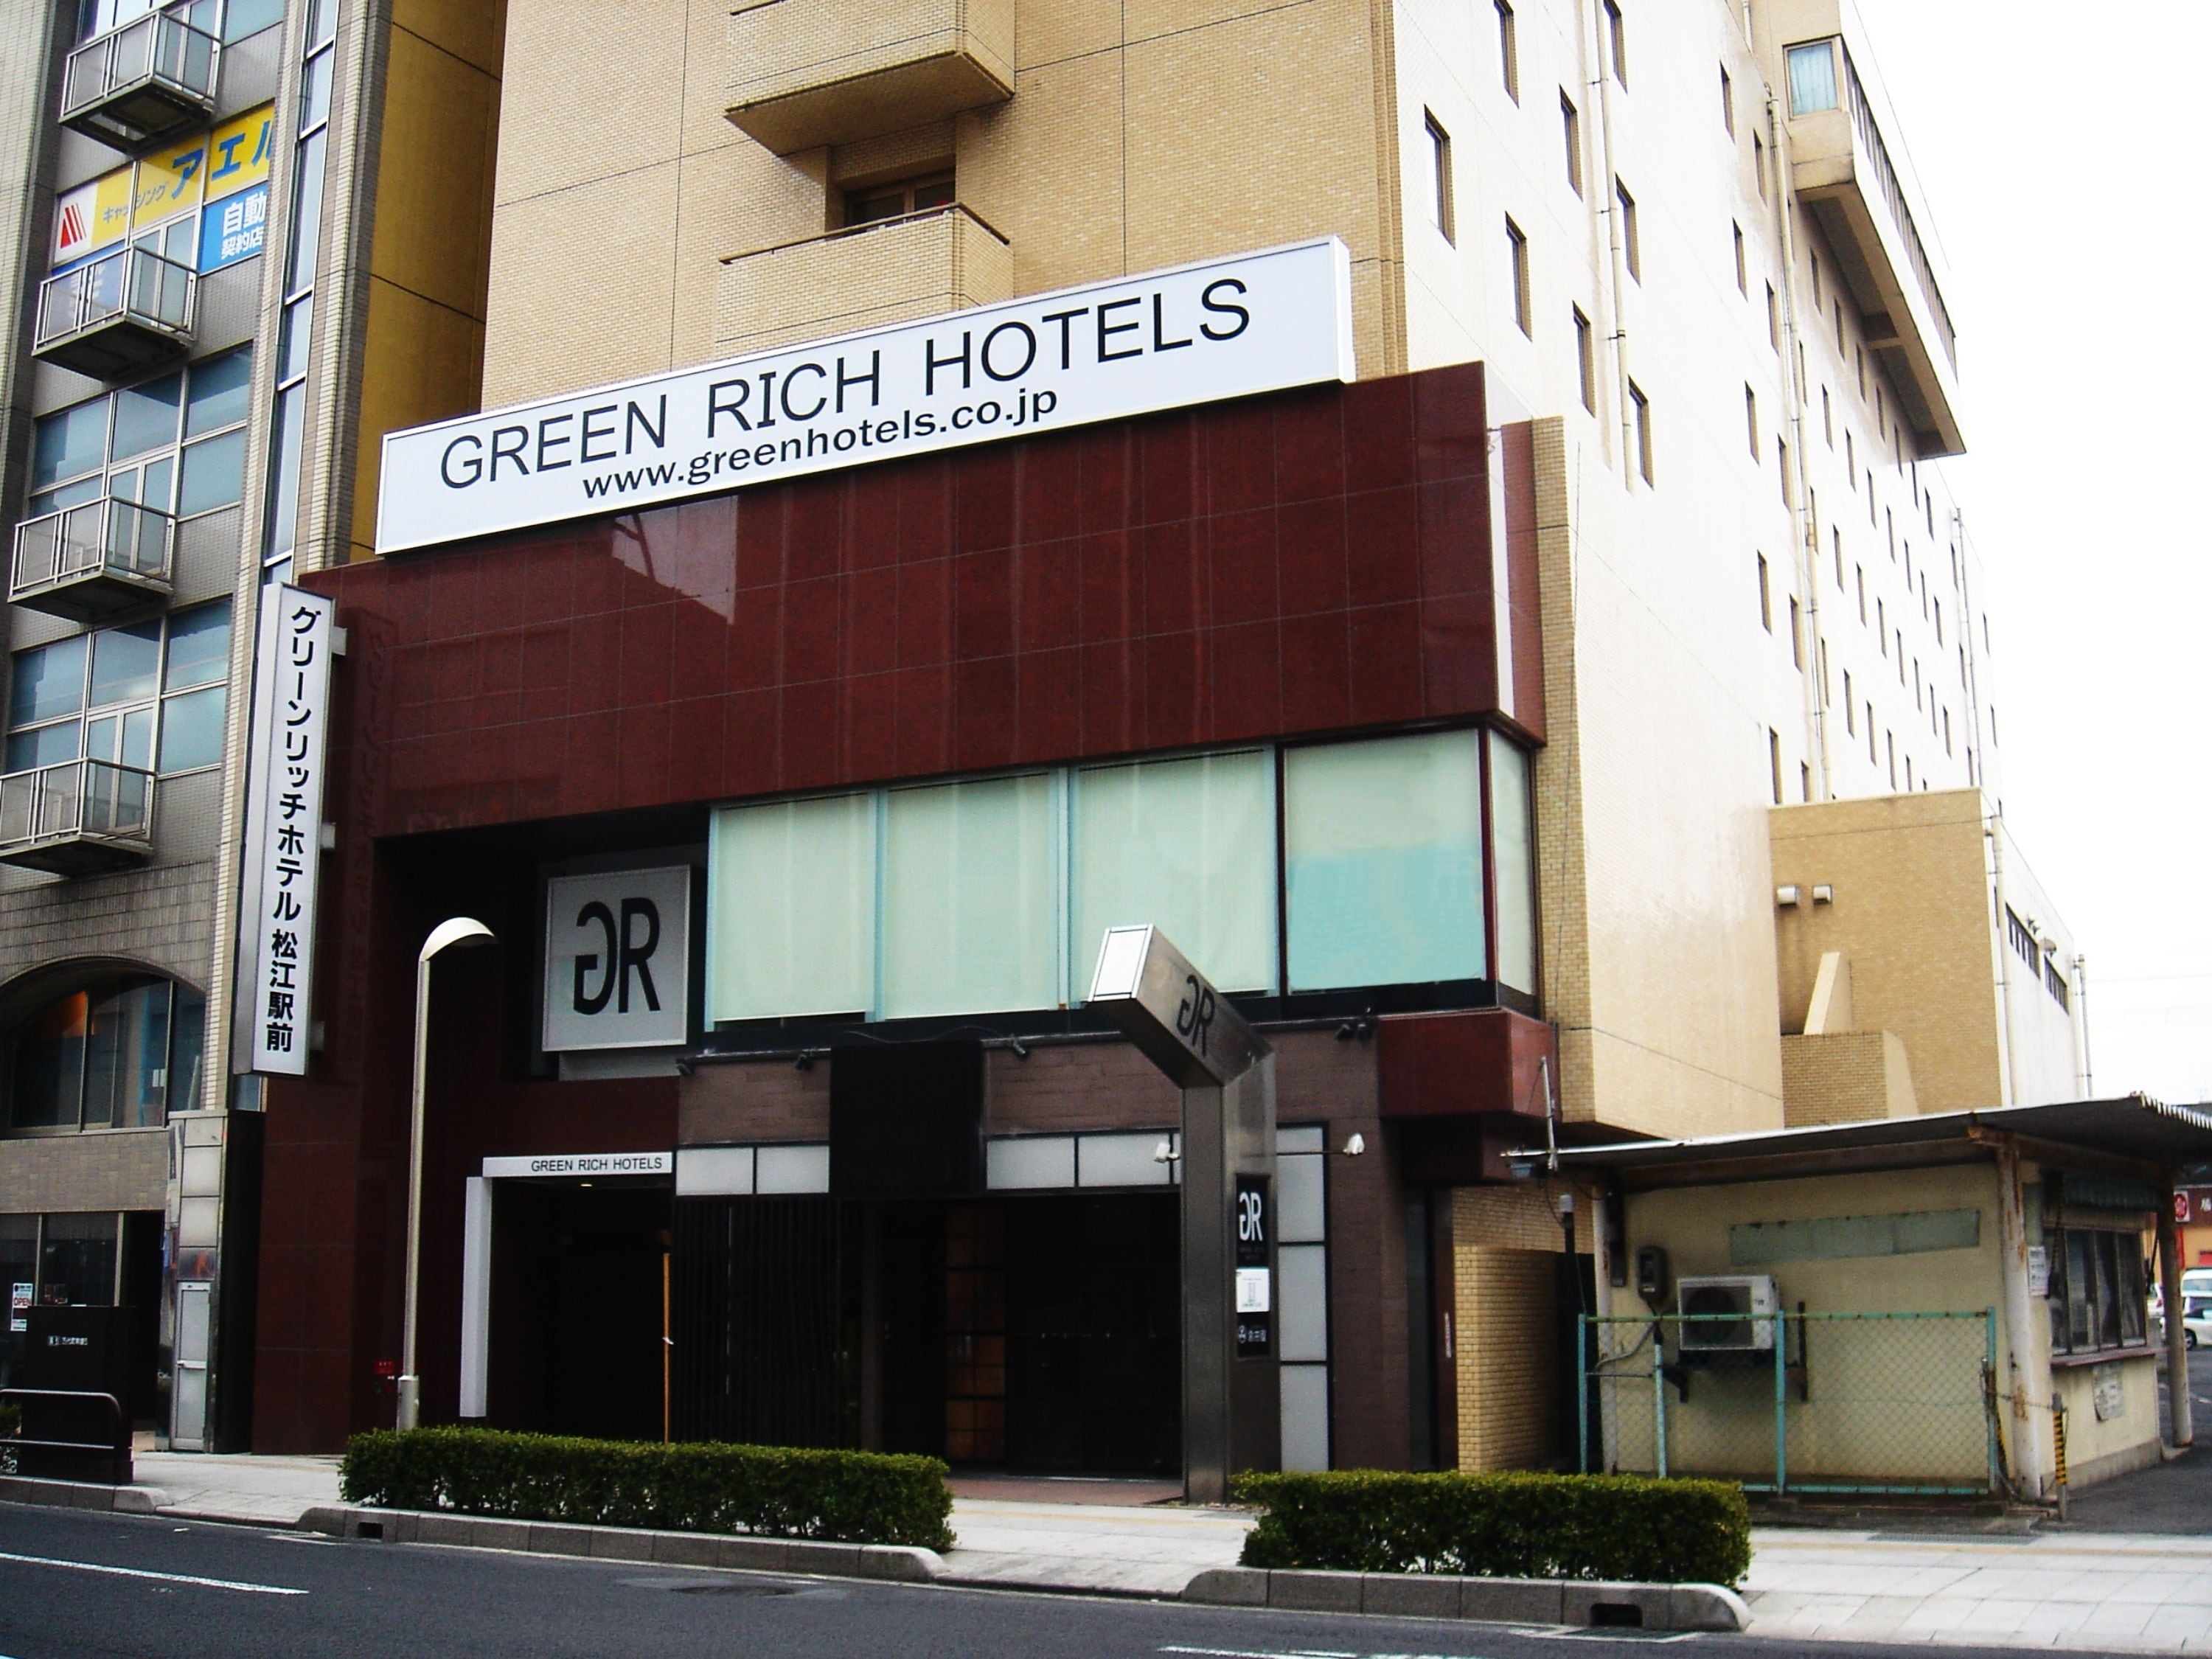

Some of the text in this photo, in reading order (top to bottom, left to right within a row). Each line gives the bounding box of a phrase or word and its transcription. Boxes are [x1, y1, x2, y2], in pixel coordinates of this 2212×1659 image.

[223, 191, 268, 237] 自動
[221, 226, 264, 260] 契約店
[441, 278, 1251, 490] GREEN RICH HOTELS
[582, 387, 1058, 499] www.greenhotels.co.jp
[531, 1157, 662, 1172] GREEN RICH HOTELS
